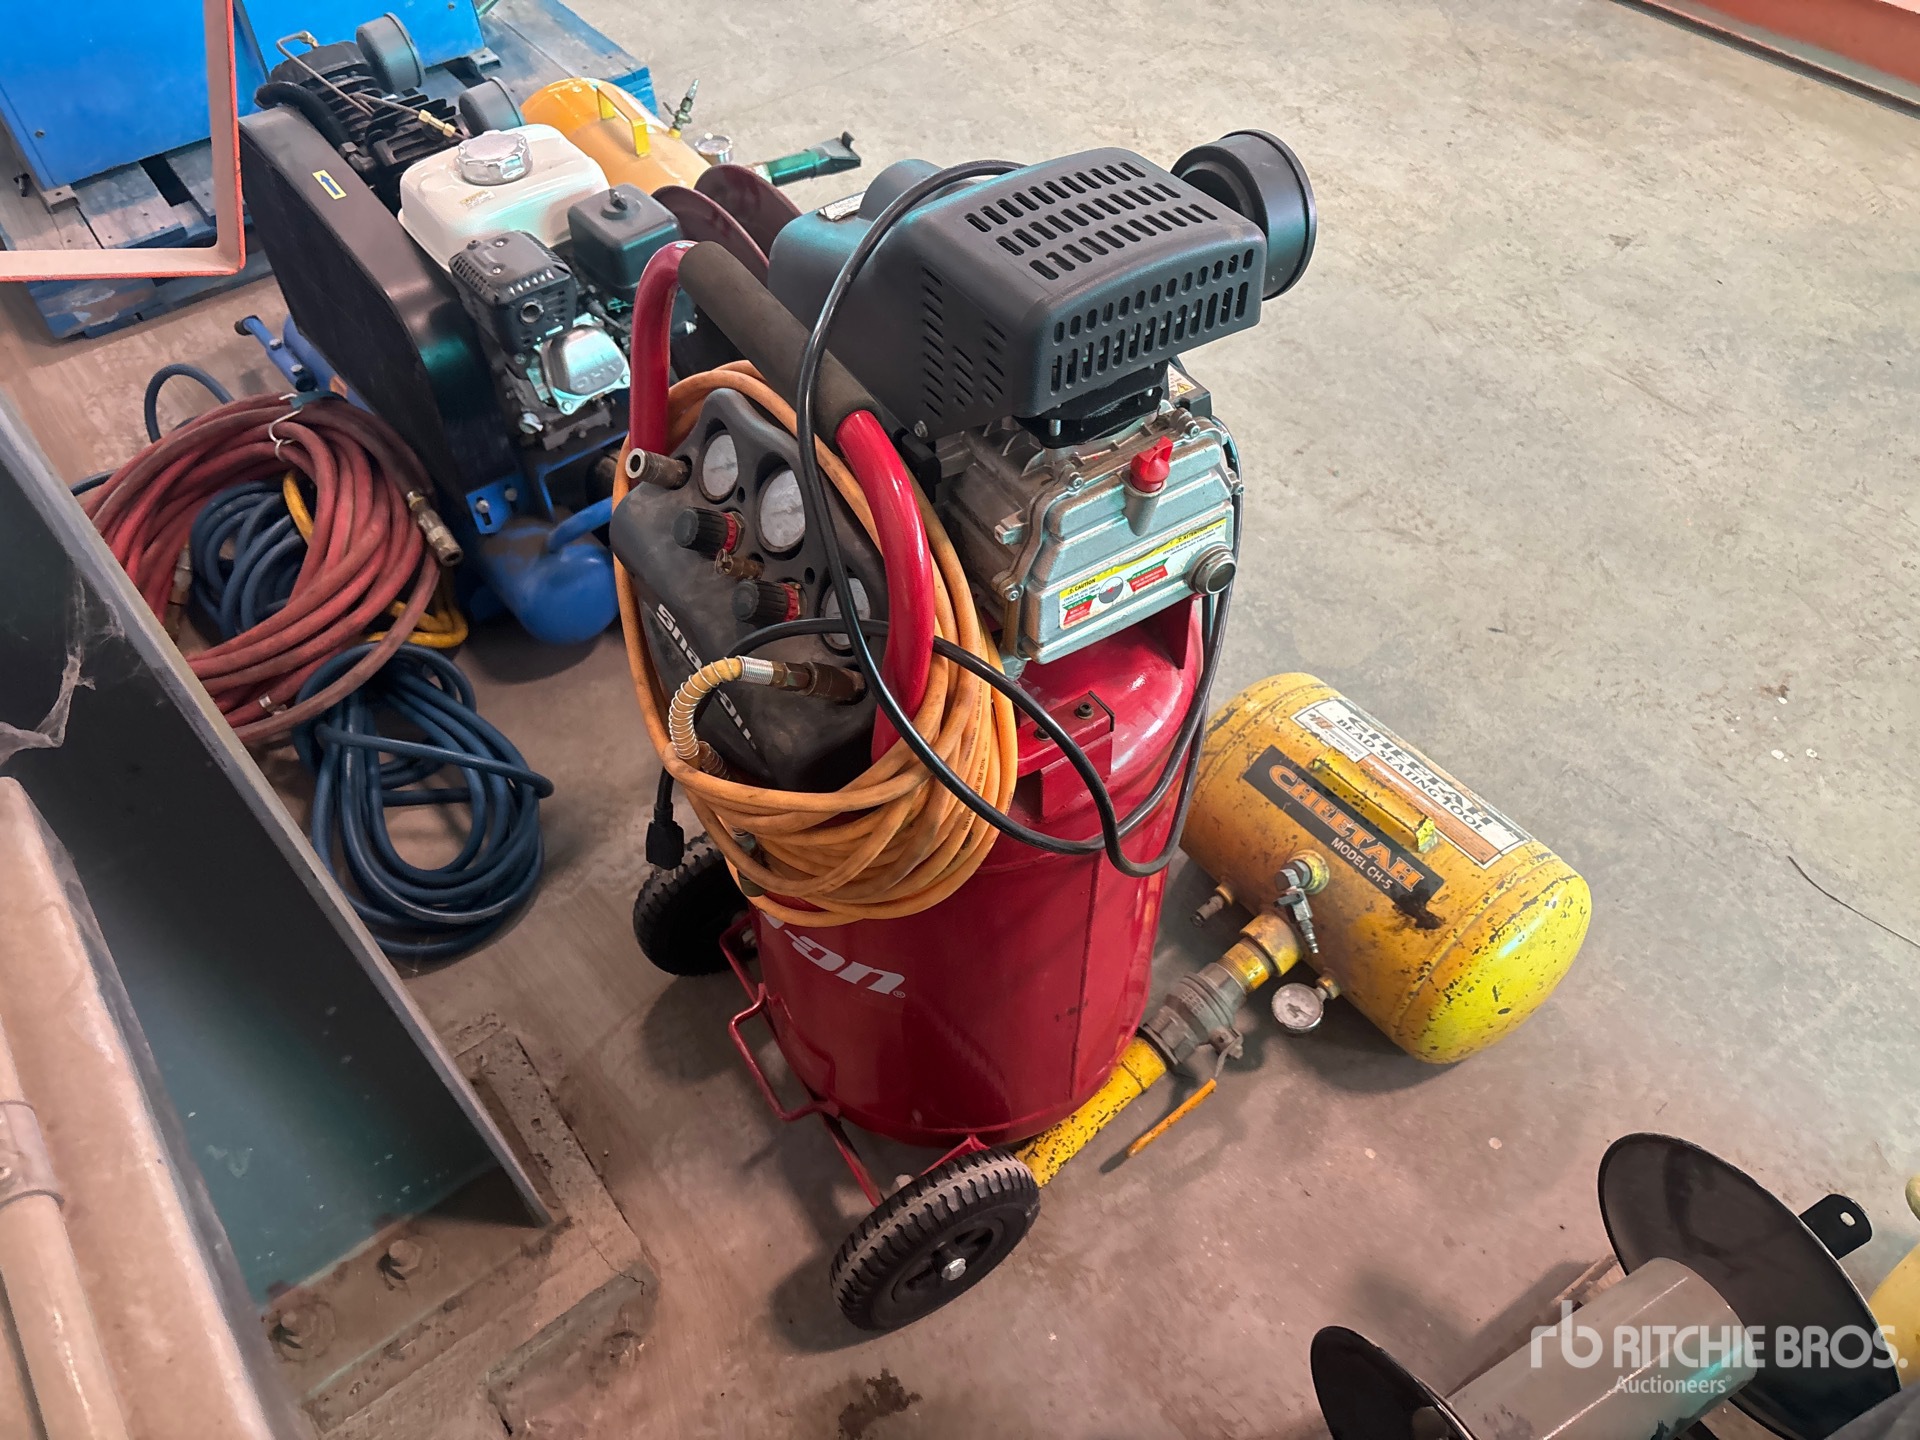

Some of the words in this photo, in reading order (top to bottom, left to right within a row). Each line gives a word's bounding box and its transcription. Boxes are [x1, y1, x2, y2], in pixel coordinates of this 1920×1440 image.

[1073, 577, 1096, 591] CAUTION
[656, 603, 753, 743] Sna-on
[1336, 718, 1376, 748] BEAD
[1376, 748, 1439, 799] SEATING
[1442, 798, 1484, 833] TOOL
[1348, 715, 1494, 826] CHEETAH
[1269, 764, 1425, 893] CHEETAH
[1331, 837, 1366, 871] MODEL
[1366, 866, 1394, 890] CH-5
